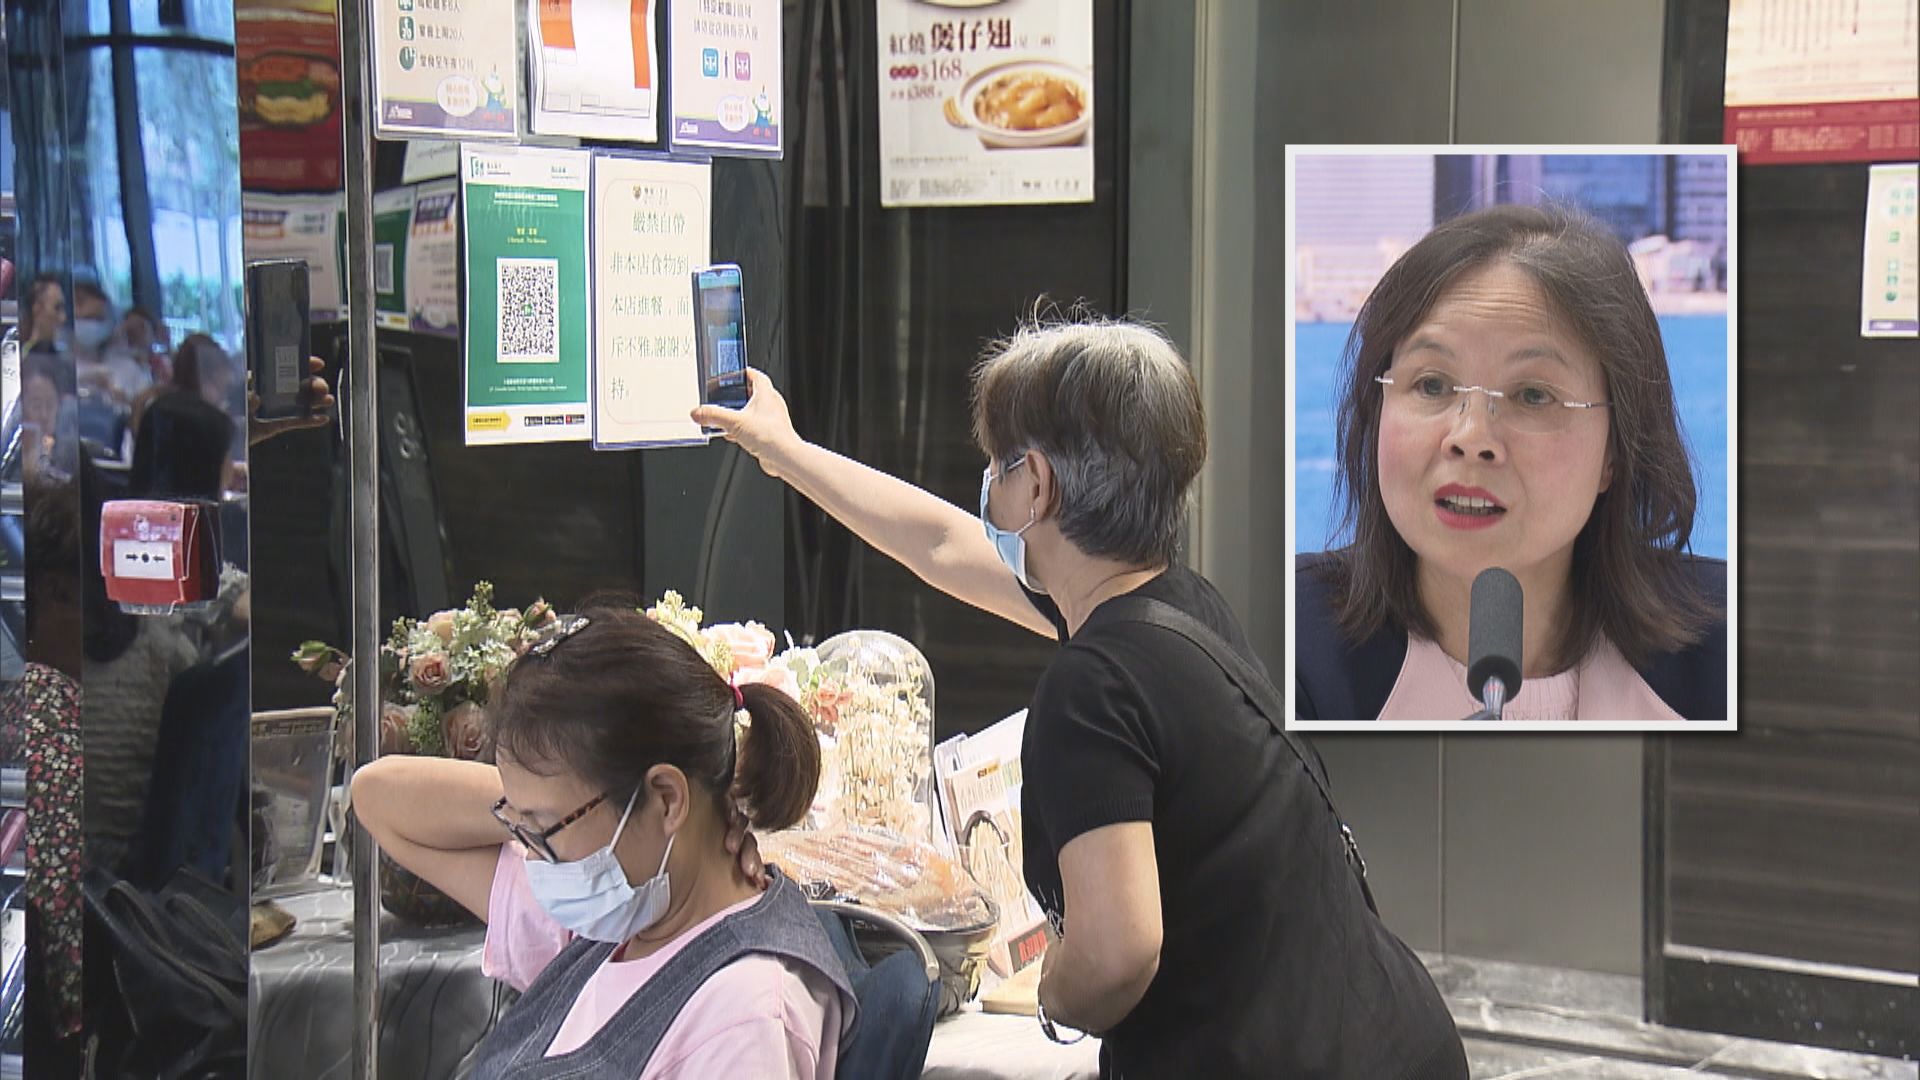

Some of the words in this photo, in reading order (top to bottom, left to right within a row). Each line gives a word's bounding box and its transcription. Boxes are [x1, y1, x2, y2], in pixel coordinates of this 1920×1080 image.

[931, 18, 1011, 52] 煲仔翅
[920, 57, 962, 81] $168
[632, 209, 685, 234] 嚴禁自帶
[610, 251, 689, 277] 非本店食物到
